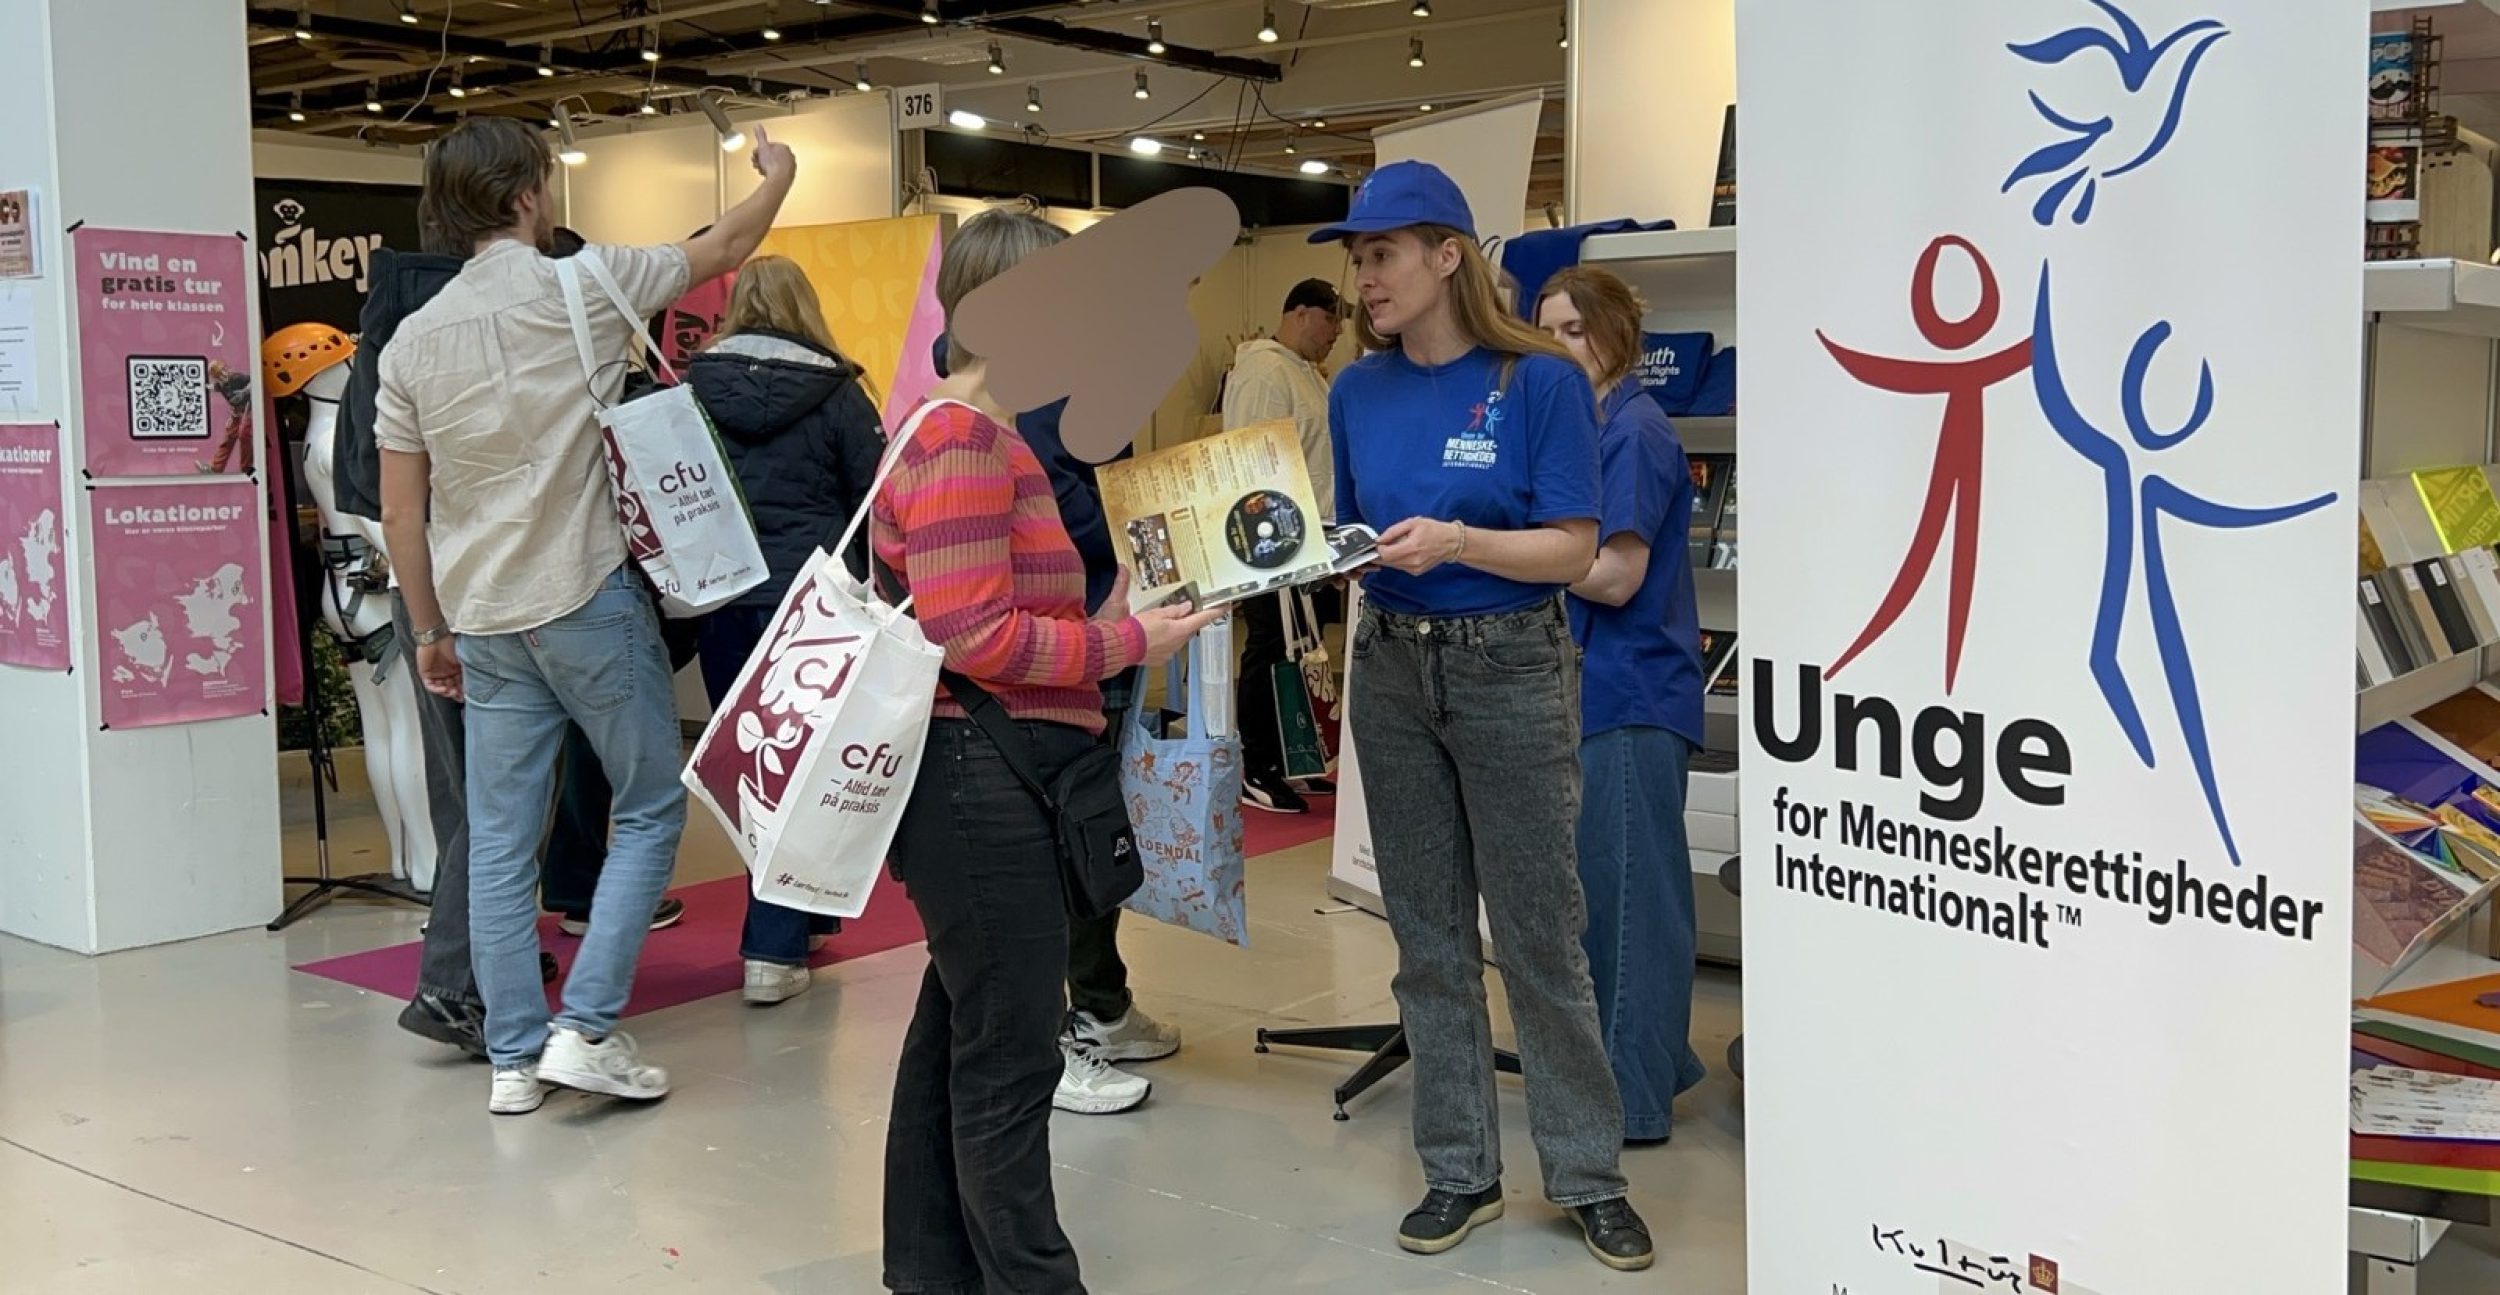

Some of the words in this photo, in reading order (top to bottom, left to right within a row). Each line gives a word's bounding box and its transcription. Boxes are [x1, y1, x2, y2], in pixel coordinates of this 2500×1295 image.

[905, 93, 933, 117] 376
[99, 252, 159, 272] Vind
[167, 257, 198, 273] en
[101, 275, 176, 294] gratis
[184, 277, 222, 295] tur
[102, 298, 125, 310] for
[130, 299, 163, 311] hele
[167, 300, 225, 312] klassen
[659, 461, 707, 493] cfu
[678, 491, 699, 508] Altid
[104, 504, 243, 525] Lokationer
[688, 500, 721, 522] praksis
[1752, 657, 2073, 822] Unge
[841, 743, 904, 778] cfu
[842, 777, 871, 796] Altid
[820, 791, 839, 807] på
[839, 797, 881, 814] praksis
[1773, 787, 1828, 840] for
[1840, 801, 2323, 942] Menneskerettigheder
